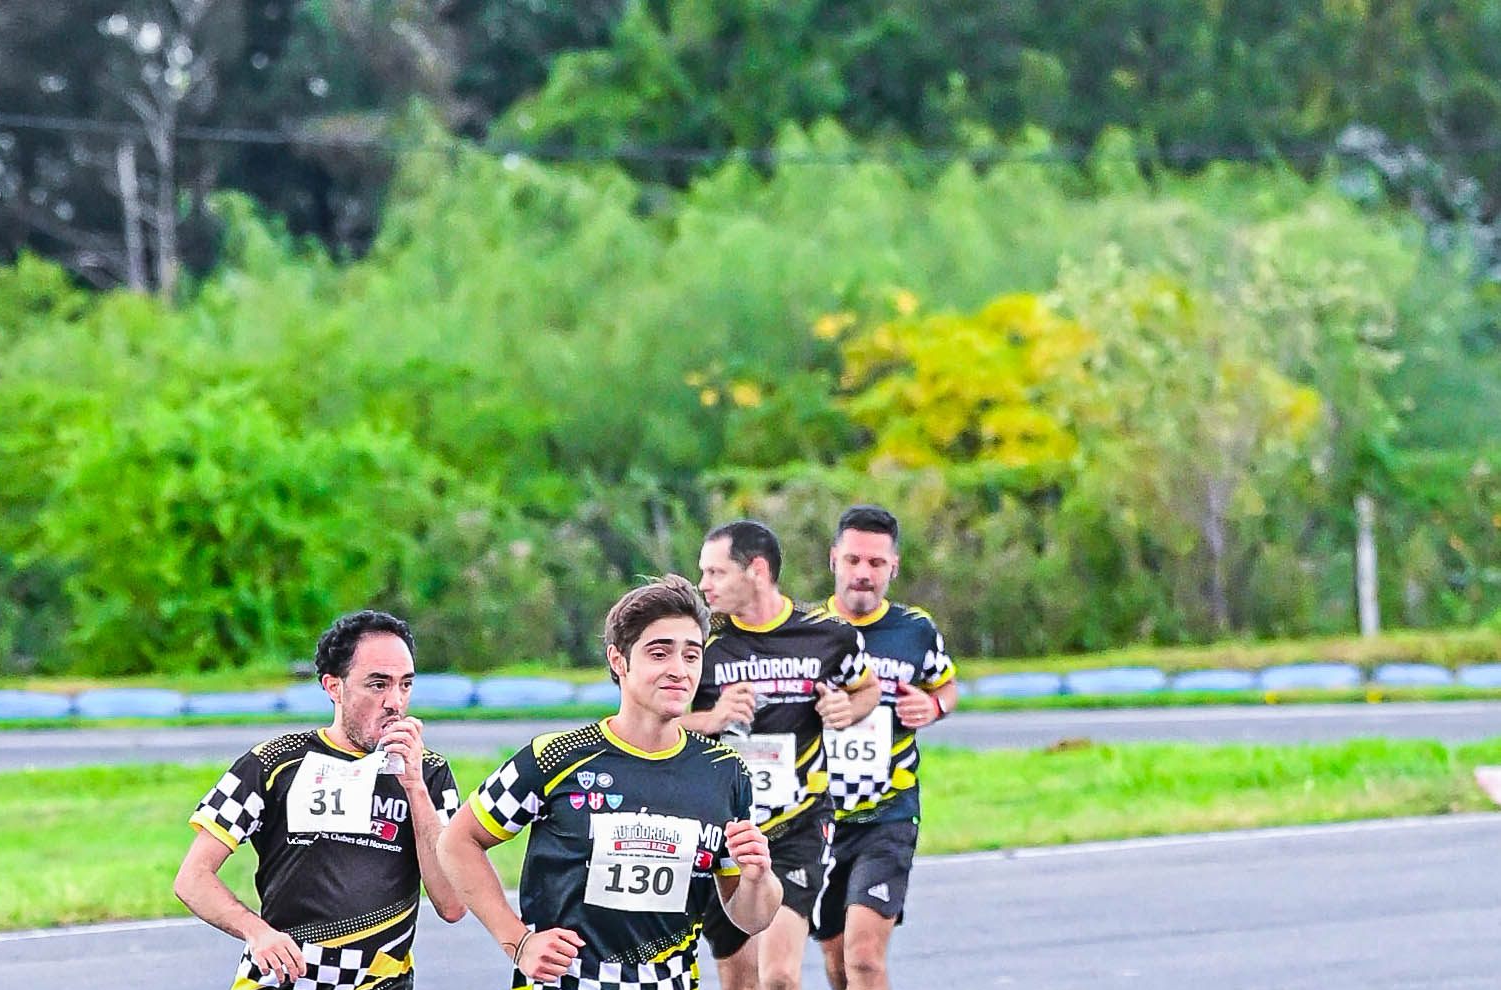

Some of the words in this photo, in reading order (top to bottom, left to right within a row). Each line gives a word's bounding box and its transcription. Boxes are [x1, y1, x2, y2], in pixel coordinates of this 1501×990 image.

[714, 655, 821, 685] AUTÓDROMO
[827, 739, 876, 761] 165
[753, 770, 772, 791] 3
[309, 788, 345, 816] 31
[330, 833, 355, 845] Clubes
[356, 837, 368, 847] del
[369, 840, 403, 853] Noroeste
[610, 821, 682, 845] AUTÓDROMO
[605, 864, 674, 895] 130
